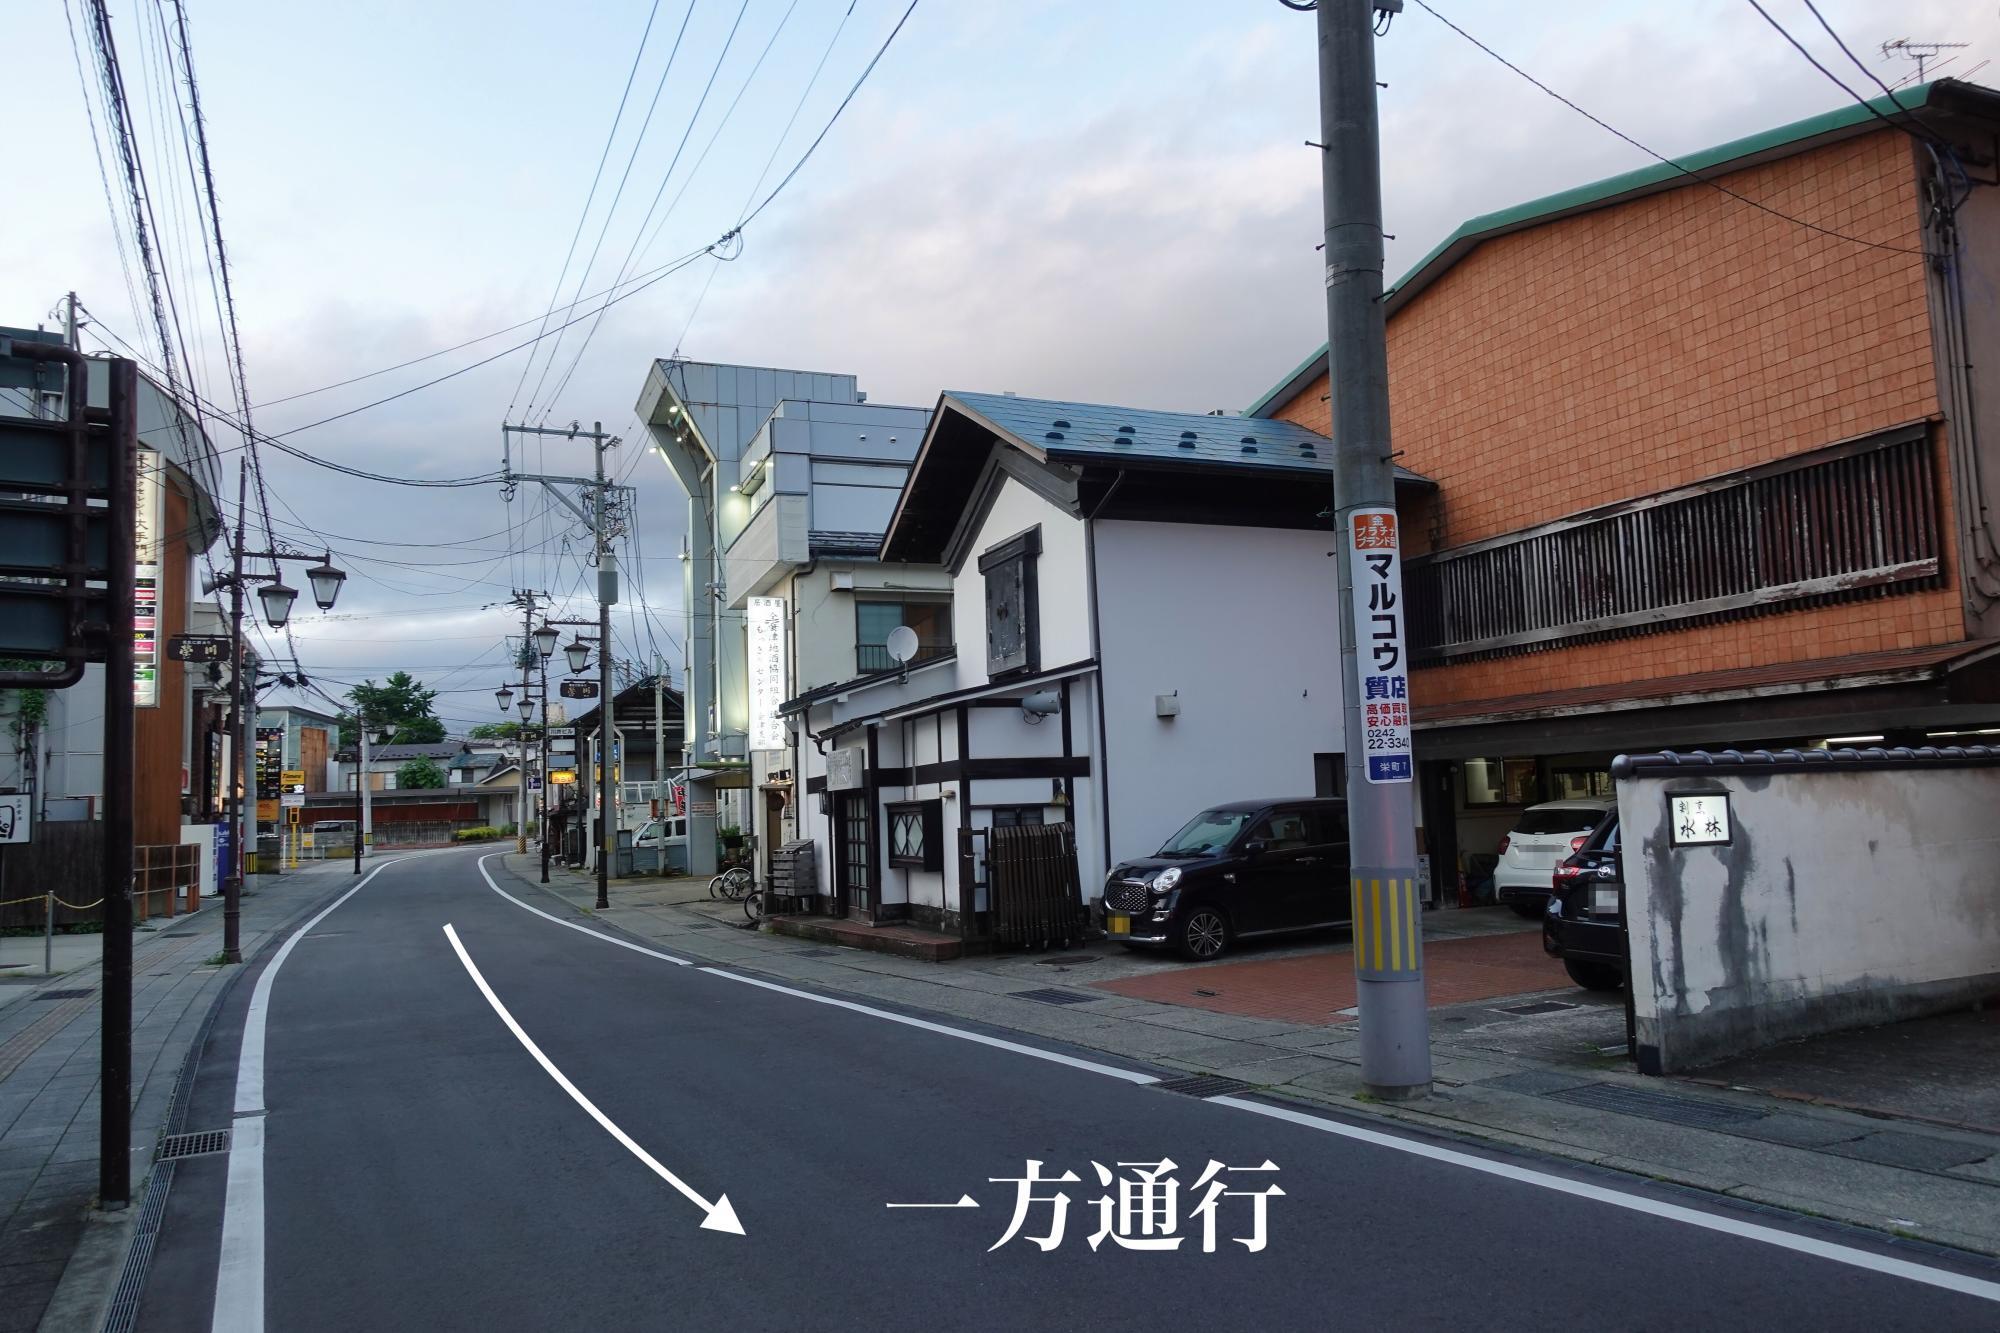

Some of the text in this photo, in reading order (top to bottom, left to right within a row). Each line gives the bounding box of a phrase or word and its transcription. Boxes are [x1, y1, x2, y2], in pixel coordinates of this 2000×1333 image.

[1372, 515, 1384, 526] 金
[1356, 526, 1396, 538] プラチナ
[1356, 536, 1396, 548] ブランド品
[1365, 554, 1399, 671] マルコウ
[1365, 675, 1406, 700] 質店
[1366, 703, 1408, 715] 高価買取
[1367, 715, 1408, 727] 安心融資
[1367, 728, 1395, 738] 0242
[1680, 815, 1722, 839] 水林
